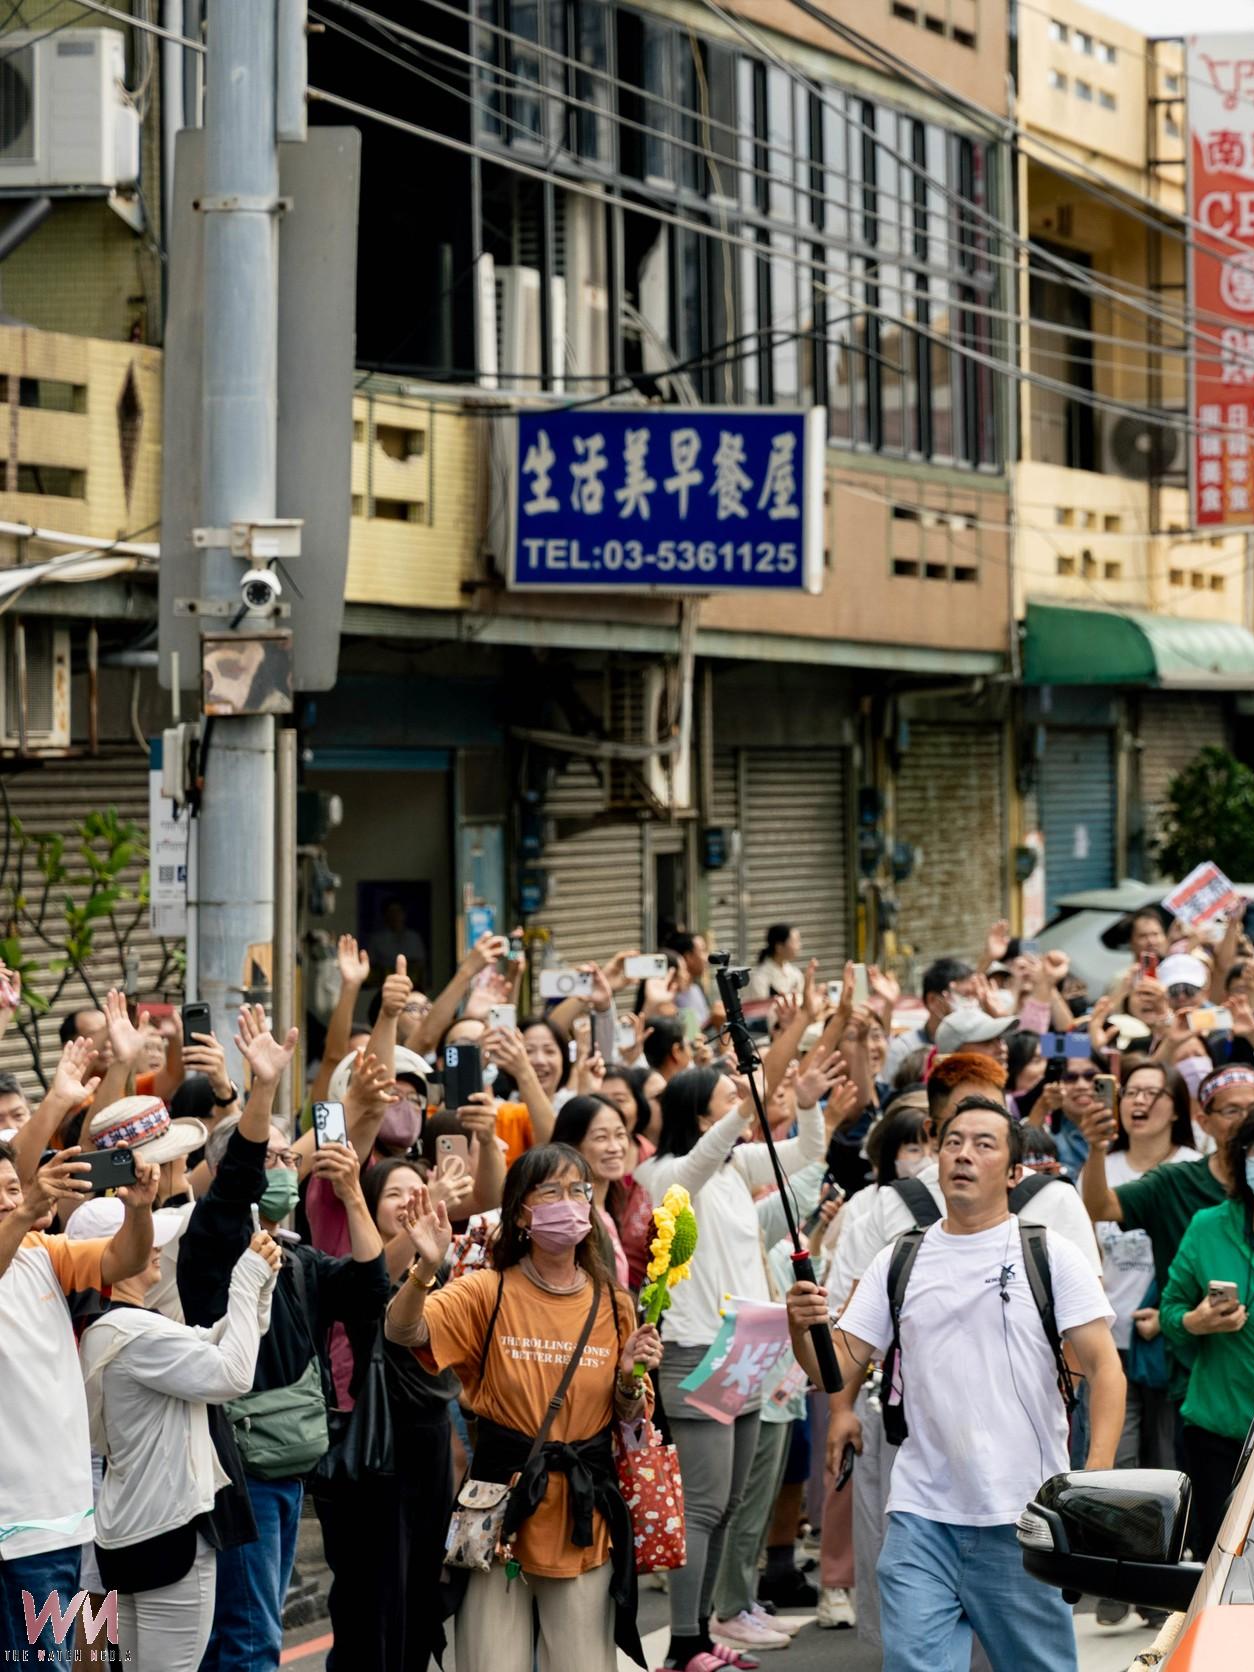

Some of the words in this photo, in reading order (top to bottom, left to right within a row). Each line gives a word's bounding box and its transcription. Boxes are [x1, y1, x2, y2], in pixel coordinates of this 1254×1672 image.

[522, 428, 800, 521] 生活美早餐屋
[522, 538, 797, 573] TEL:03-5361125
